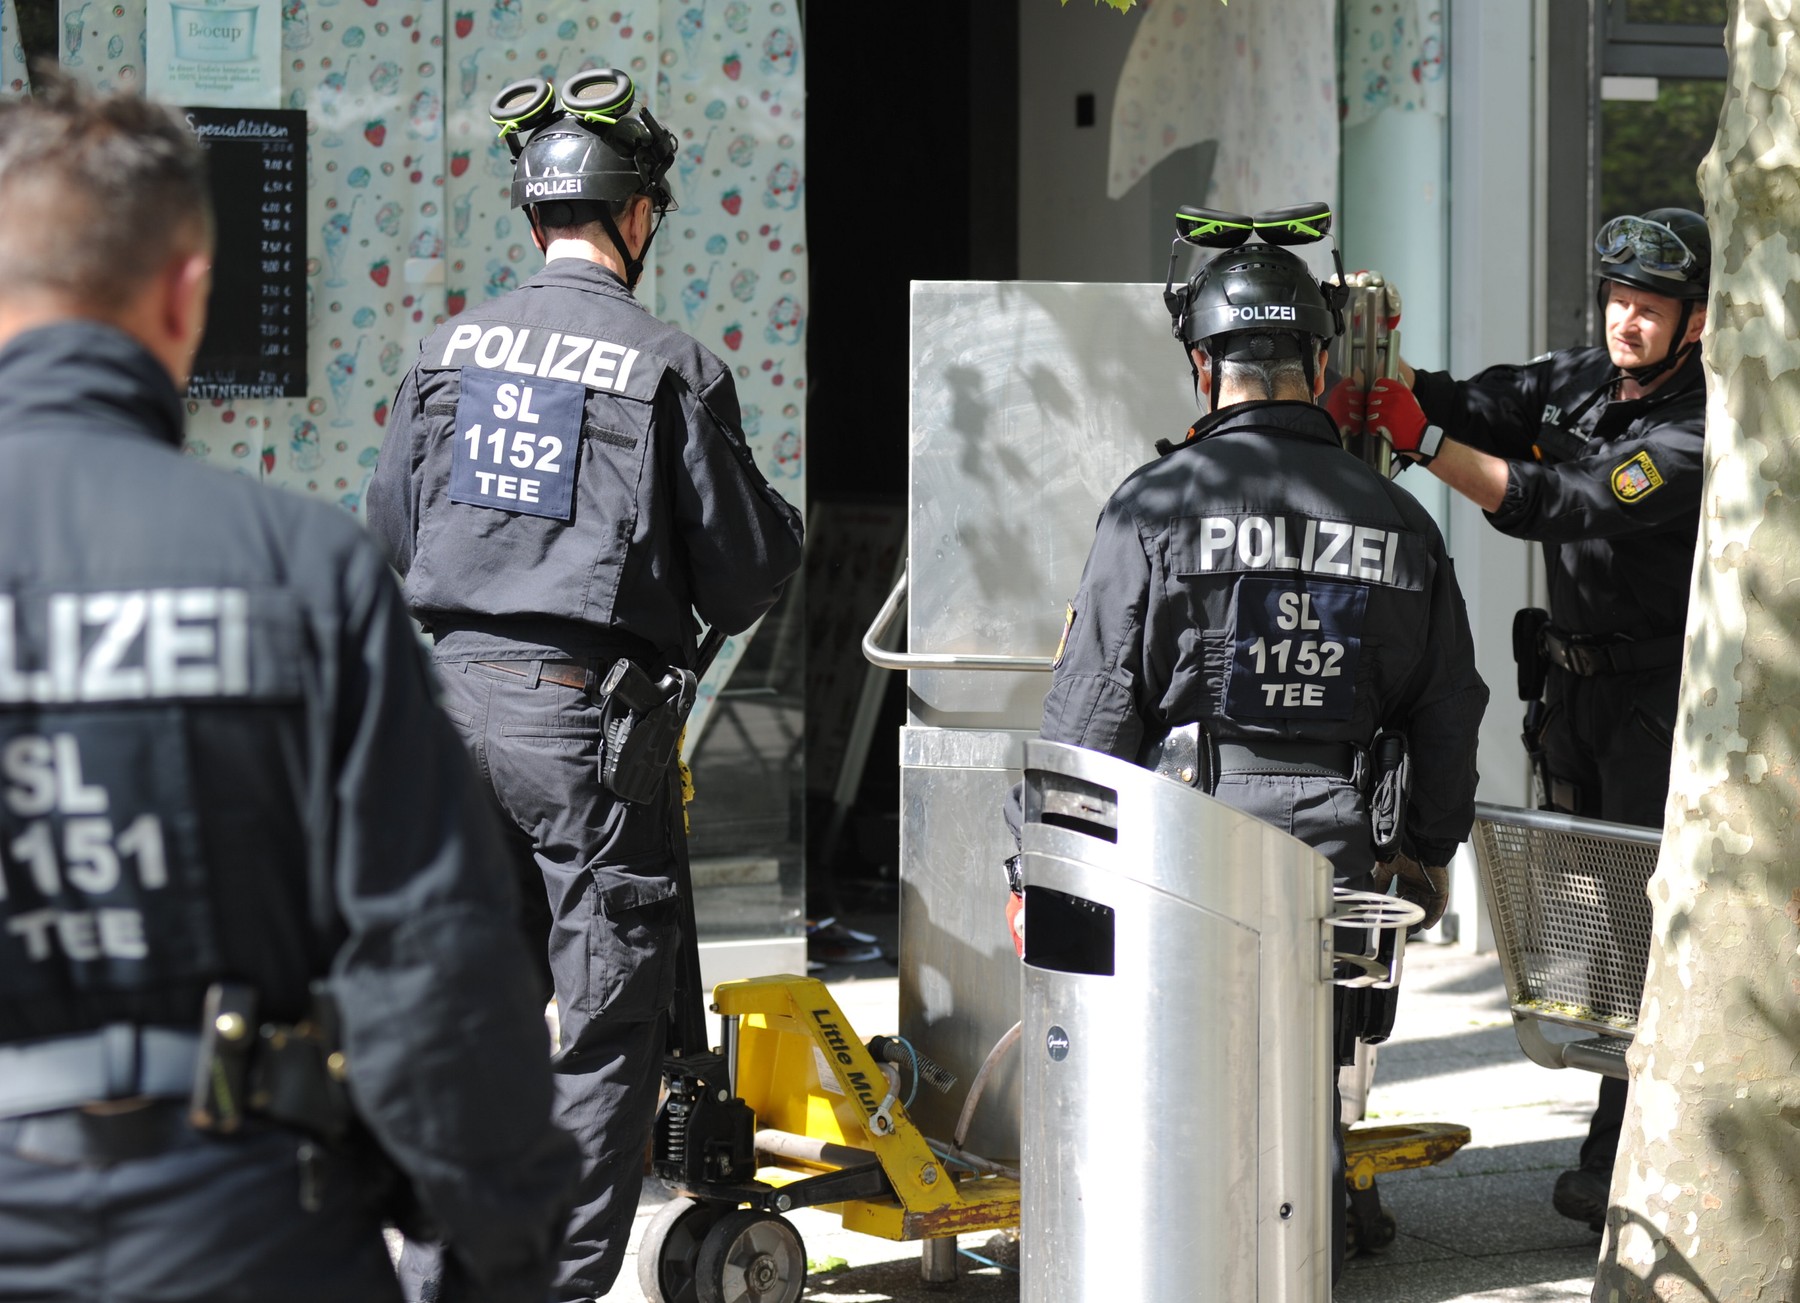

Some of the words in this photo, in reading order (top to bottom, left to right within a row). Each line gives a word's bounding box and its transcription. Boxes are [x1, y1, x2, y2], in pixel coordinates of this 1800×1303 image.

[526, 178, 582, 198] POLIZEI
[1229, 305, 1296, 321] POLIZEI
[441, 324, 639, 393] POLIZEI
[187, 384, 284, 399] MITNEHMEN
[493, 384, 540, 424] SL
[464, 424, 563, 473] 1152
[475, 471, 541, 503] TEE
[1200, 516, 1399, 583] POLIZEI
[1276, 592, 1320, 631] SL
[1249, 637, 1345, 677] 1152
[1261, 683, 1326, 707] TEE
[3, 734, 109, 816] SL
[0, 813, 168, 898] 151
[7, 907, 149, 961] TEE
[812, 1009, 853, 1066] Little
[847, 1071, 879, 1117] Mul
